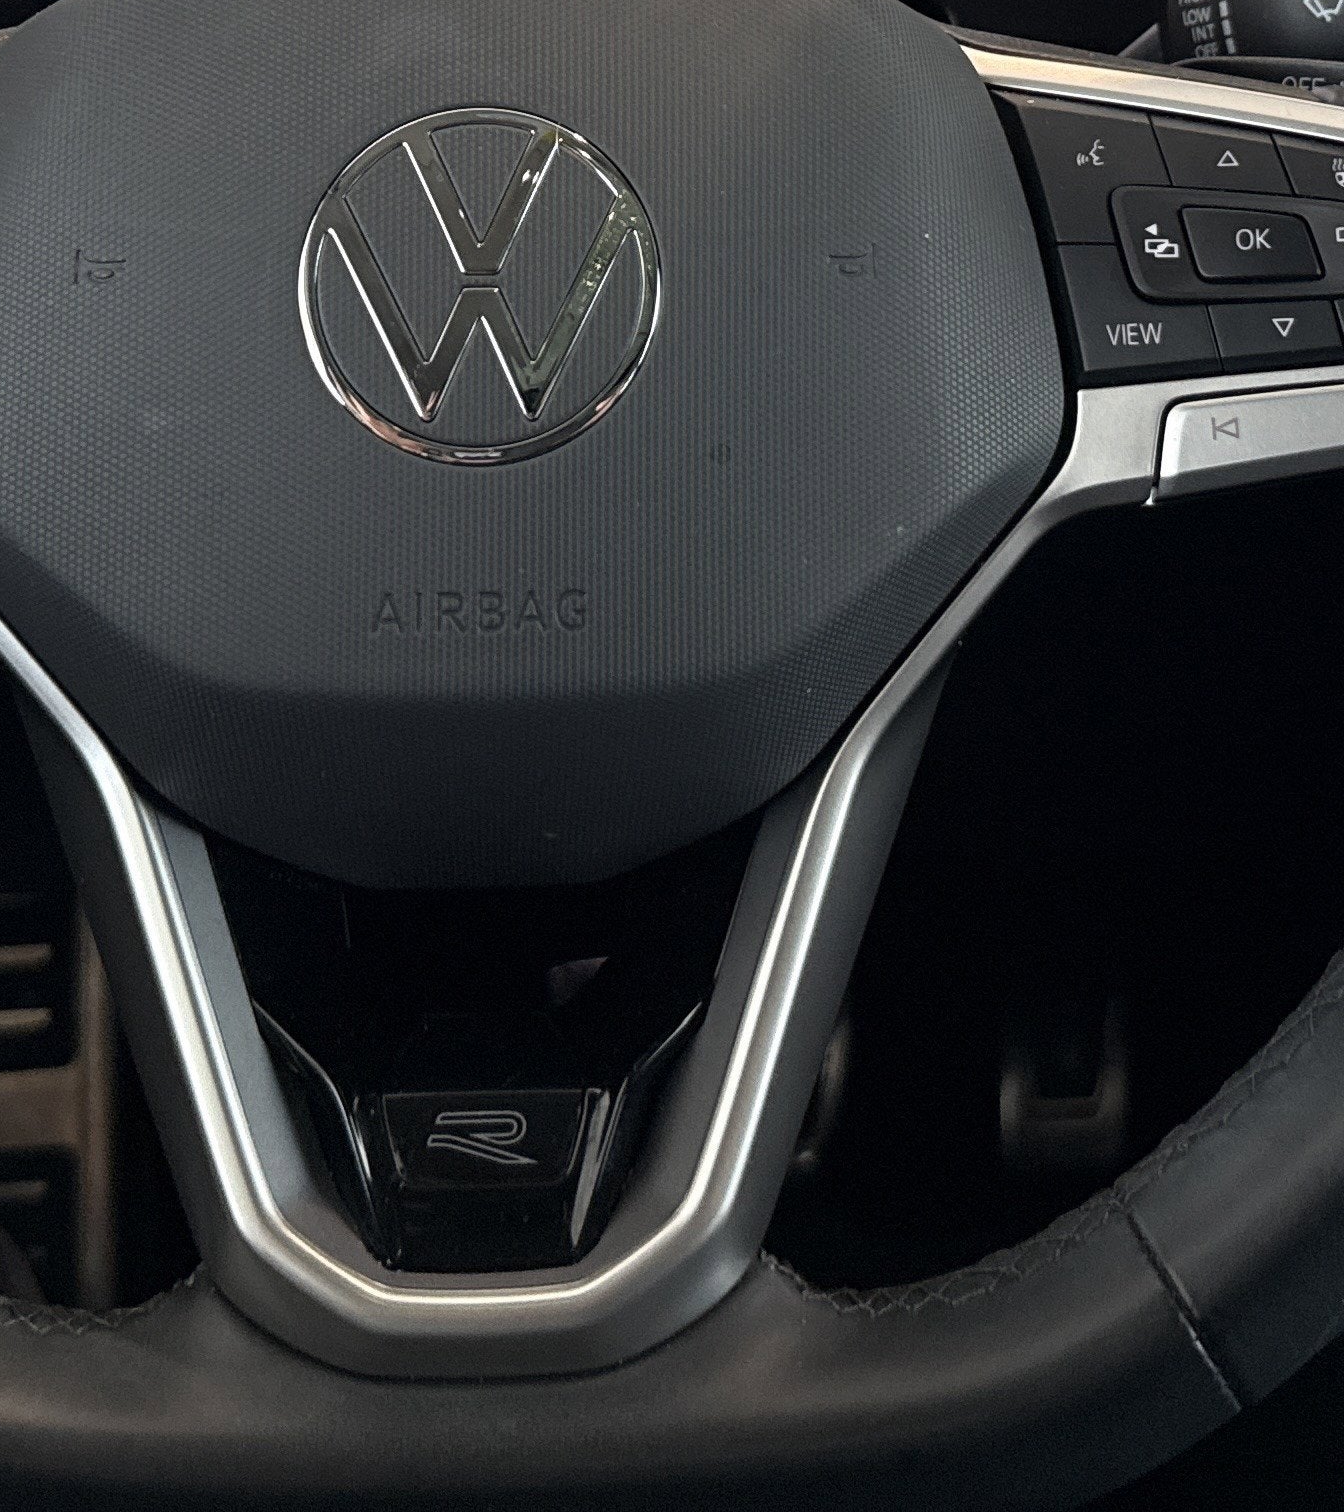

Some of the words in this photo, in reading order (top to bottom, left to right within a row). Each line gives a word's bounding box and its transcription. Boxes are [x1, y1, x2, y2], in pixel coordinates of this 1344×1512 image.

[1234, 228, 1272, 252] OK
[1106, 322, 1163, 348] VIEW
[369, 589, 591, 636] AIRBAG
